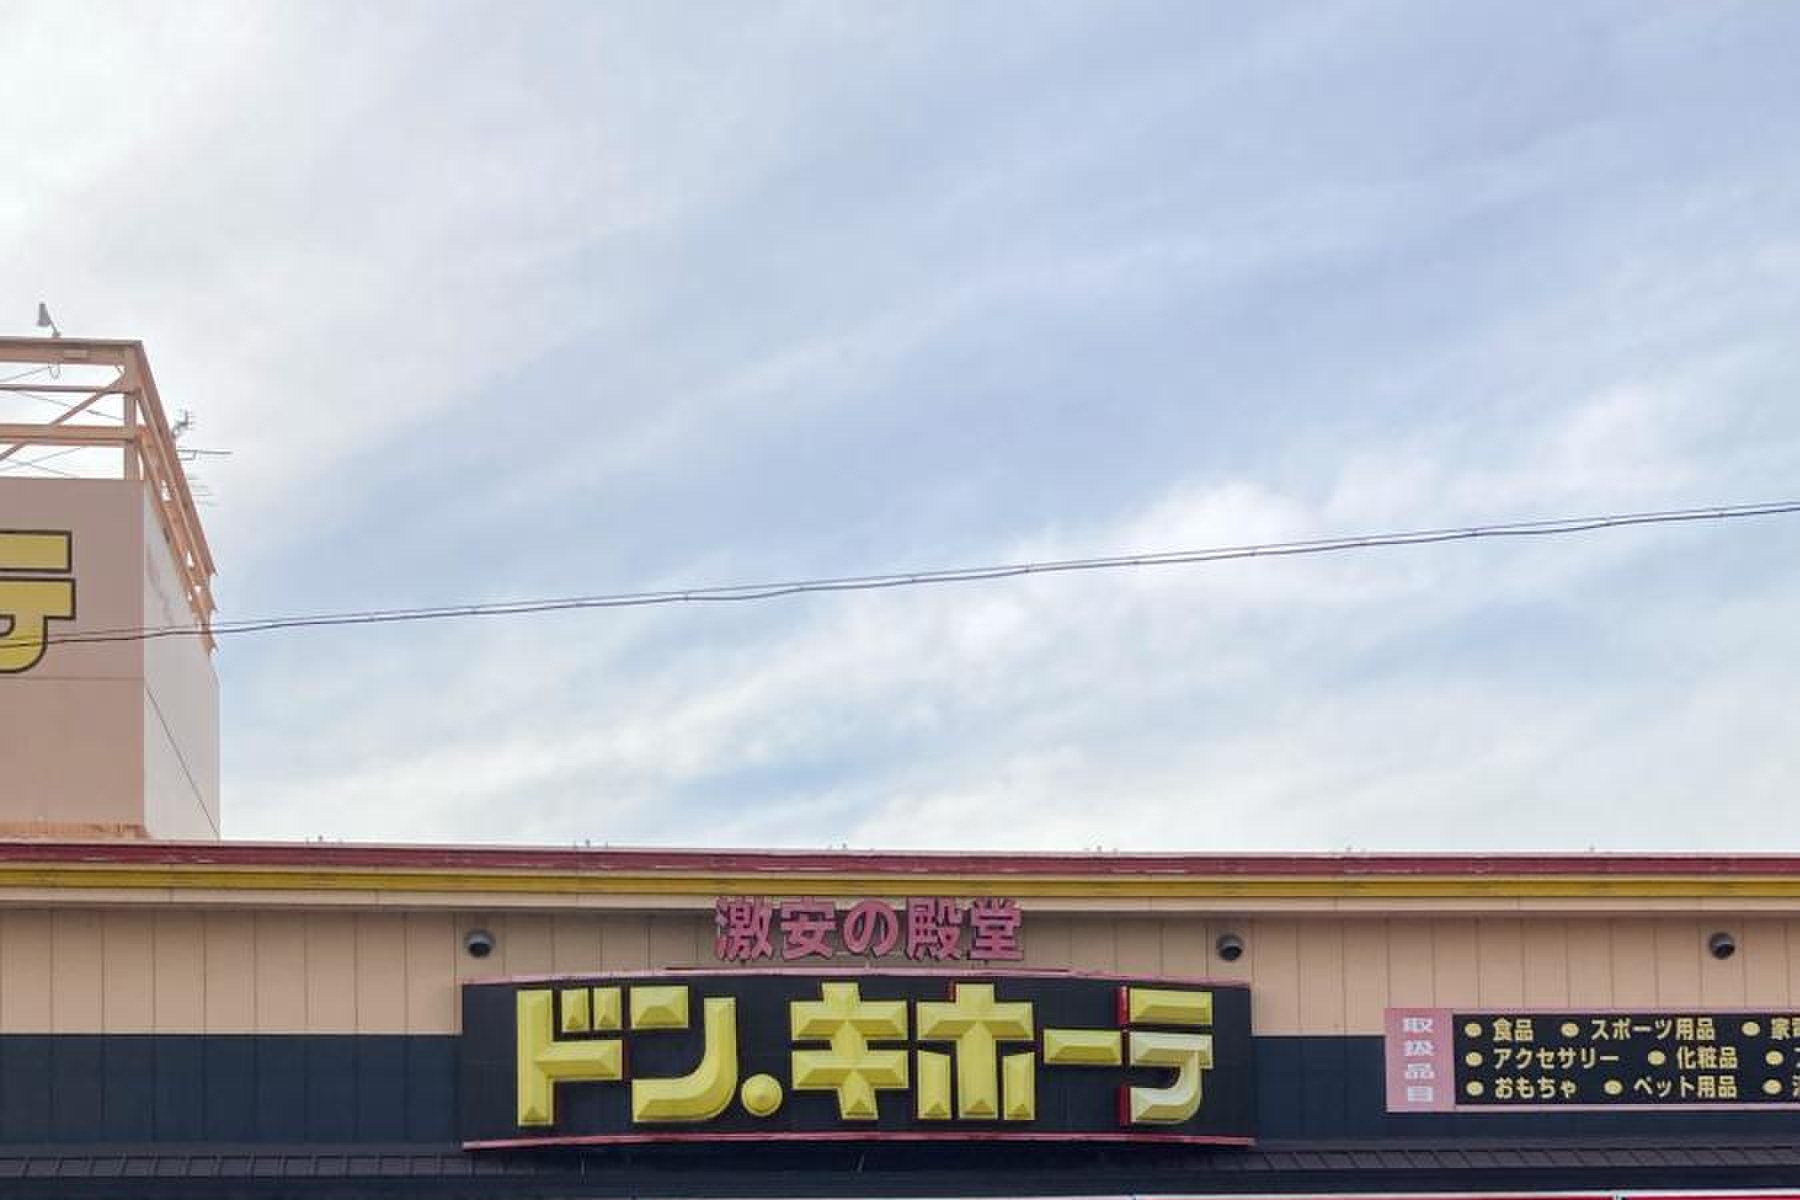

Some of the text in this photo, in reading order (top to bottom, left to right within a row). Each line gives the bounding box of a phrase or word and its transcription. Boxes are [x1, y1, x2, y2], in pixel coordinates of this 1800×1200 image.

[715, 895, 1024, 961] 激安の殿堂
[1492, 1017, 1534, 1042] 食品
[1590, 1017, 1715, 1041] スポーツ用品
[1493, 1046, 1738, 1069] アクセサリー 化粧品
[1494, 1075, 1738, 1099] おもちゃ ペット用品
